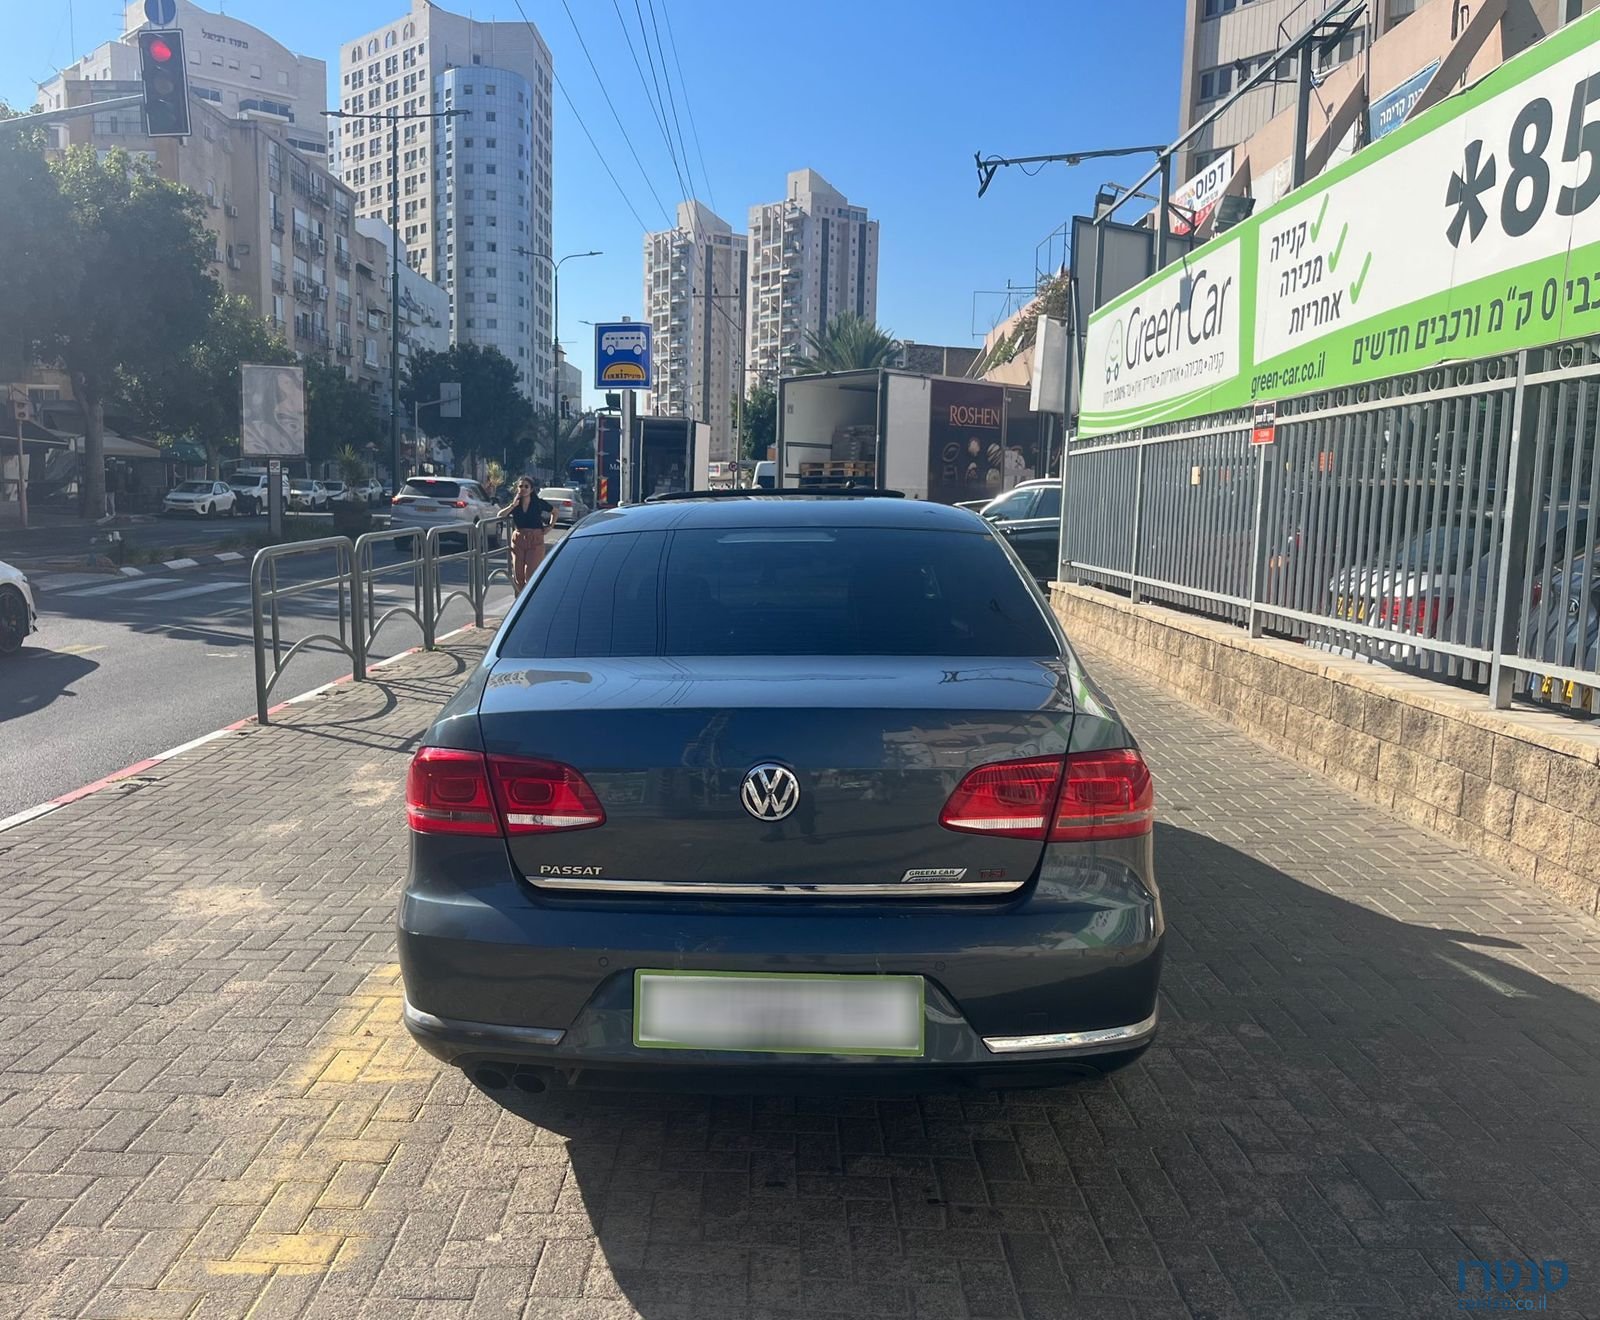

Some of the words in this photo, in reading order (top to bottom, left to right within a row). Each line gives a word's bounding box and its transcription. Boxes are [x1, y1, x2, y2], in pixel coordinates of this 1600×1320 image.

[1380, 97, 1406, 126] קדימה
[1195, 162, 1225, 200] דפוס
[1270, 221, 1307, 263] קנייה
[1279, 255, 1323, 298] מכירה
[1125, 301, 1182, 370] Green
[1187, 269, 1232, 345] Car
[1288, 289, 1344, 335] אחריות
[1541, 277, 1558, 321] 0
[1352, 325, 1410, 365] חדשים
[1414, 304, 1481, 350] ורכבים
[1250, 351, 1326, 399] green-car.co.il
[950, 405, 1000, 427] ROSHEN
[540, 865, 603, 875] PASSAT
